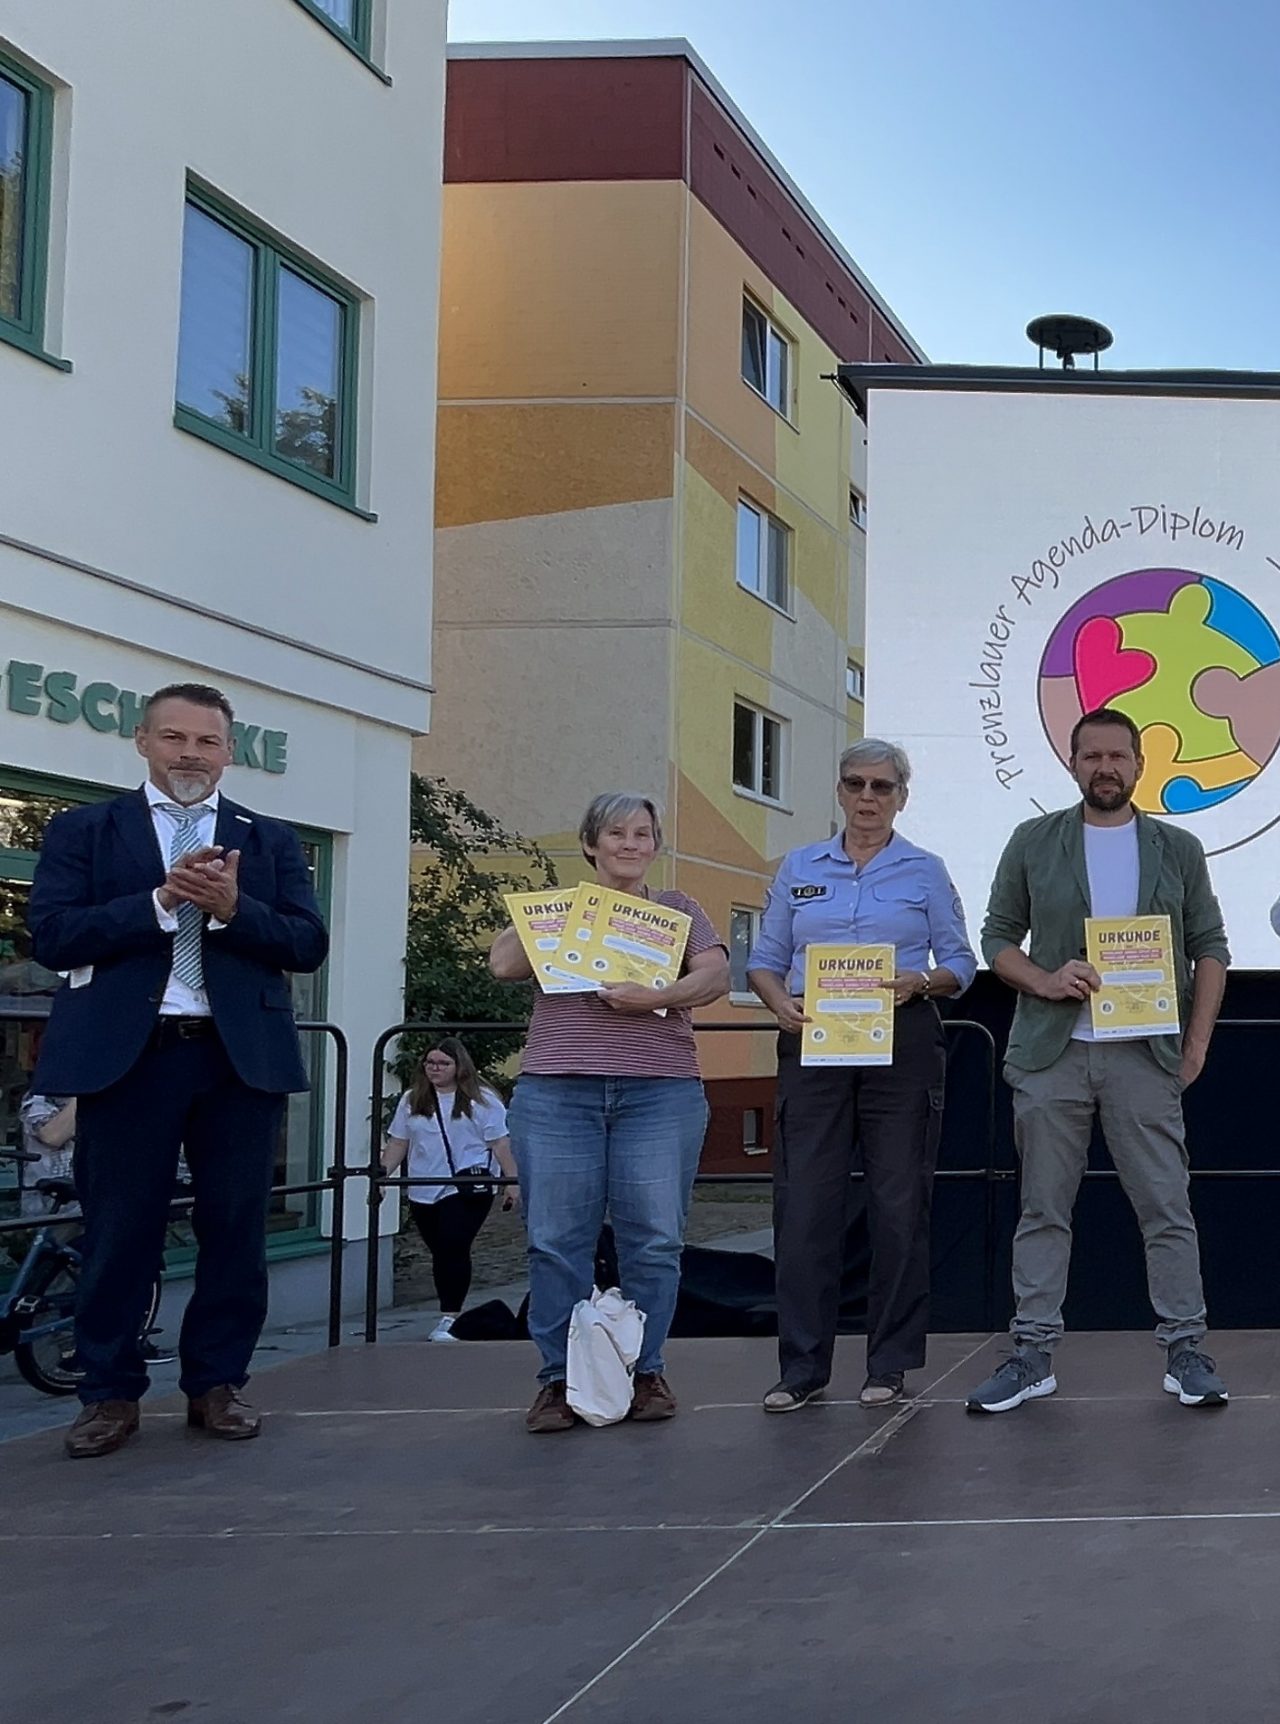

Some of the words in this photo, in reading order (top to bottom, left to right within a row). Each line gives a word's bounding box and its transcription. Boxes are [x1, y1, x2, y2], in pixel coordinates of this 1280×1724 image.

[968, 604, 1024, 790] Prenzlauer
[1010, 504, 1245, 605] Agenda-Diplom
[523, 901, 573, 915] URKUN
[612, 903, 679, 932] URKUNDE
[1098, 930, 1161, 943] URKUNDE
[818, 958, 884, 971] URKUNDE
